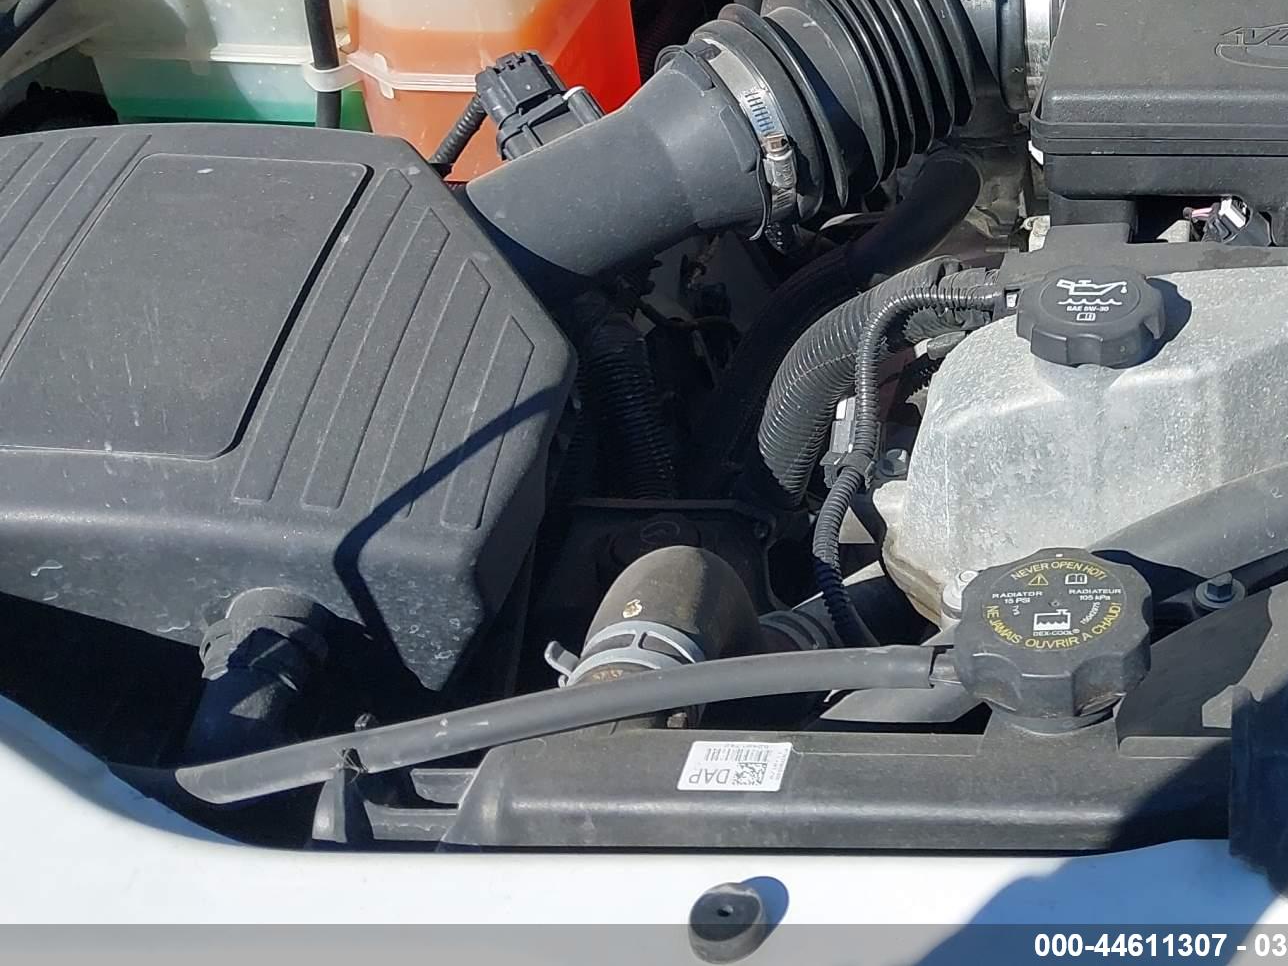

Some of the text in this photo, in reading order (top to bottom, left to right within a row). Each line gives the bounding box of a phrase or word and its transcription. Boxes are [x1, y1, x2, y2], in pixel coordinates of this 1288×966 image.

[1010, 561, 1108, 580] NEVER OPEN HOT!
[985, 605, 999, 619] NE
[1091, 602, 1122, 635] CHAUD!
[989, 619, 1022, 644] JAMAIS
[1025, 636, 1080, 649] OUVRIR
[688, 768, 730, 784] DAP
